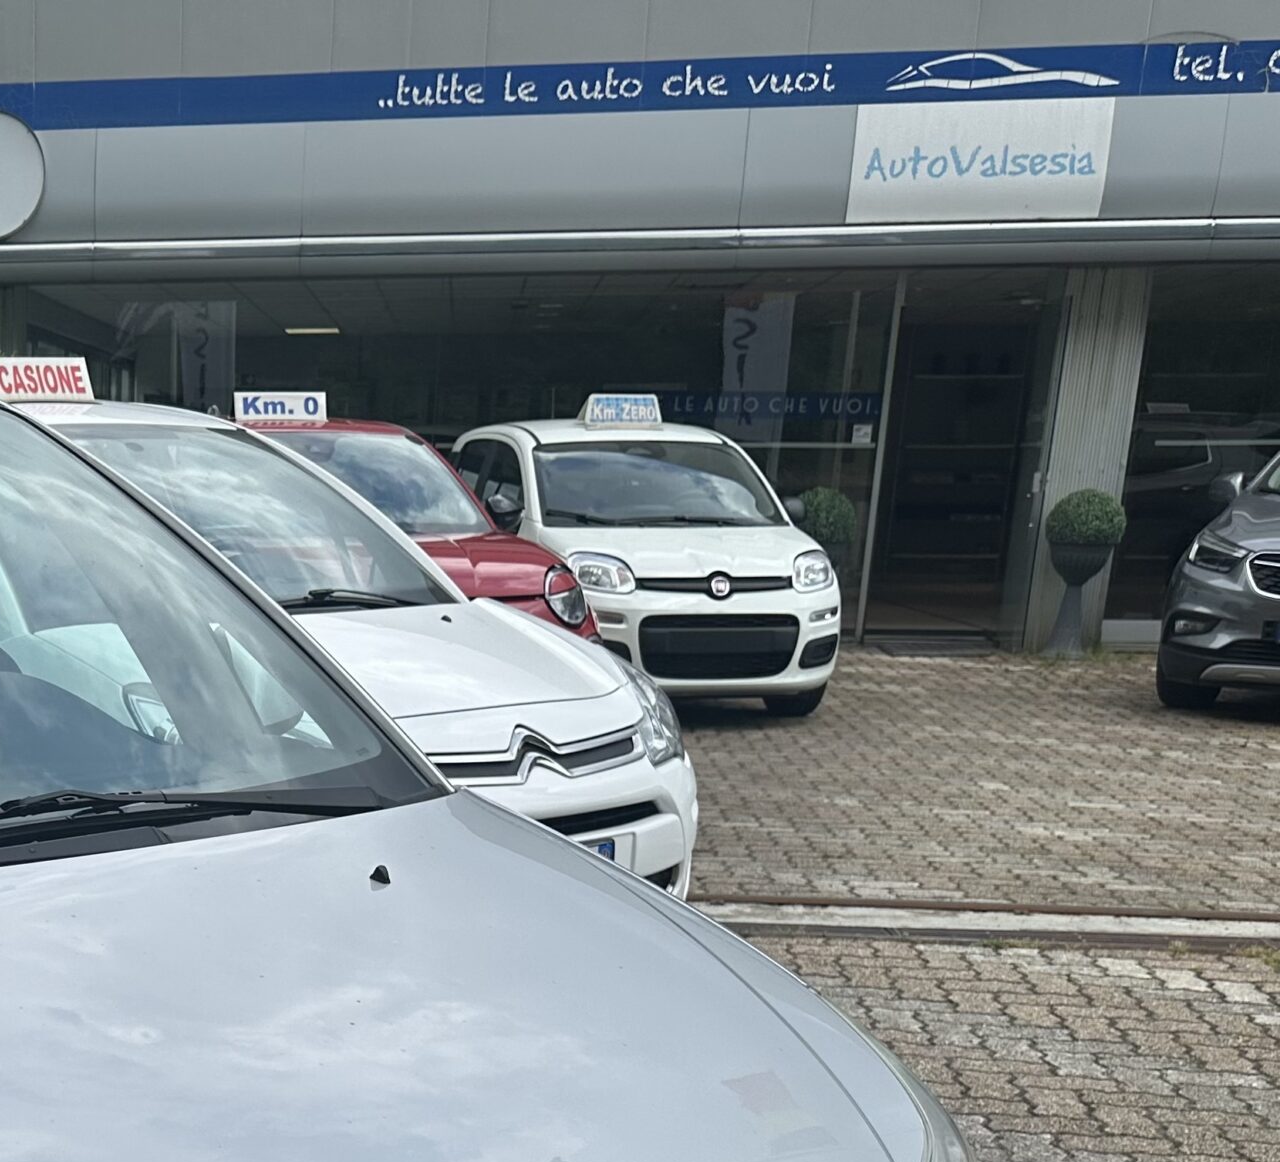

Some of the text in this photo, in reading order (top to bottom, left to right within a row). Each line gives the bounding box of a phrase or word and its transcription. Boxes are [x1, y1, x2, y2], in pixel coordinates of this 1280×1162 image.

[1173, 44, 1245, 82] tel.
[504, 71, 538, 102] le
[556, 67, 643, 101] auto
[662, 64, 728, 97] che
[747, 63, 836, 95] vuoi
[863, 143, 1097, 182] AutoValsesia
[242, 396, 319, 416] Km. 0
[593, 403, 656, 420] Km ZERO
[673, 396, 695, 412] LE
[703, 396, 759, 414] AUTO
[768, 397, 808, 414] CHE
